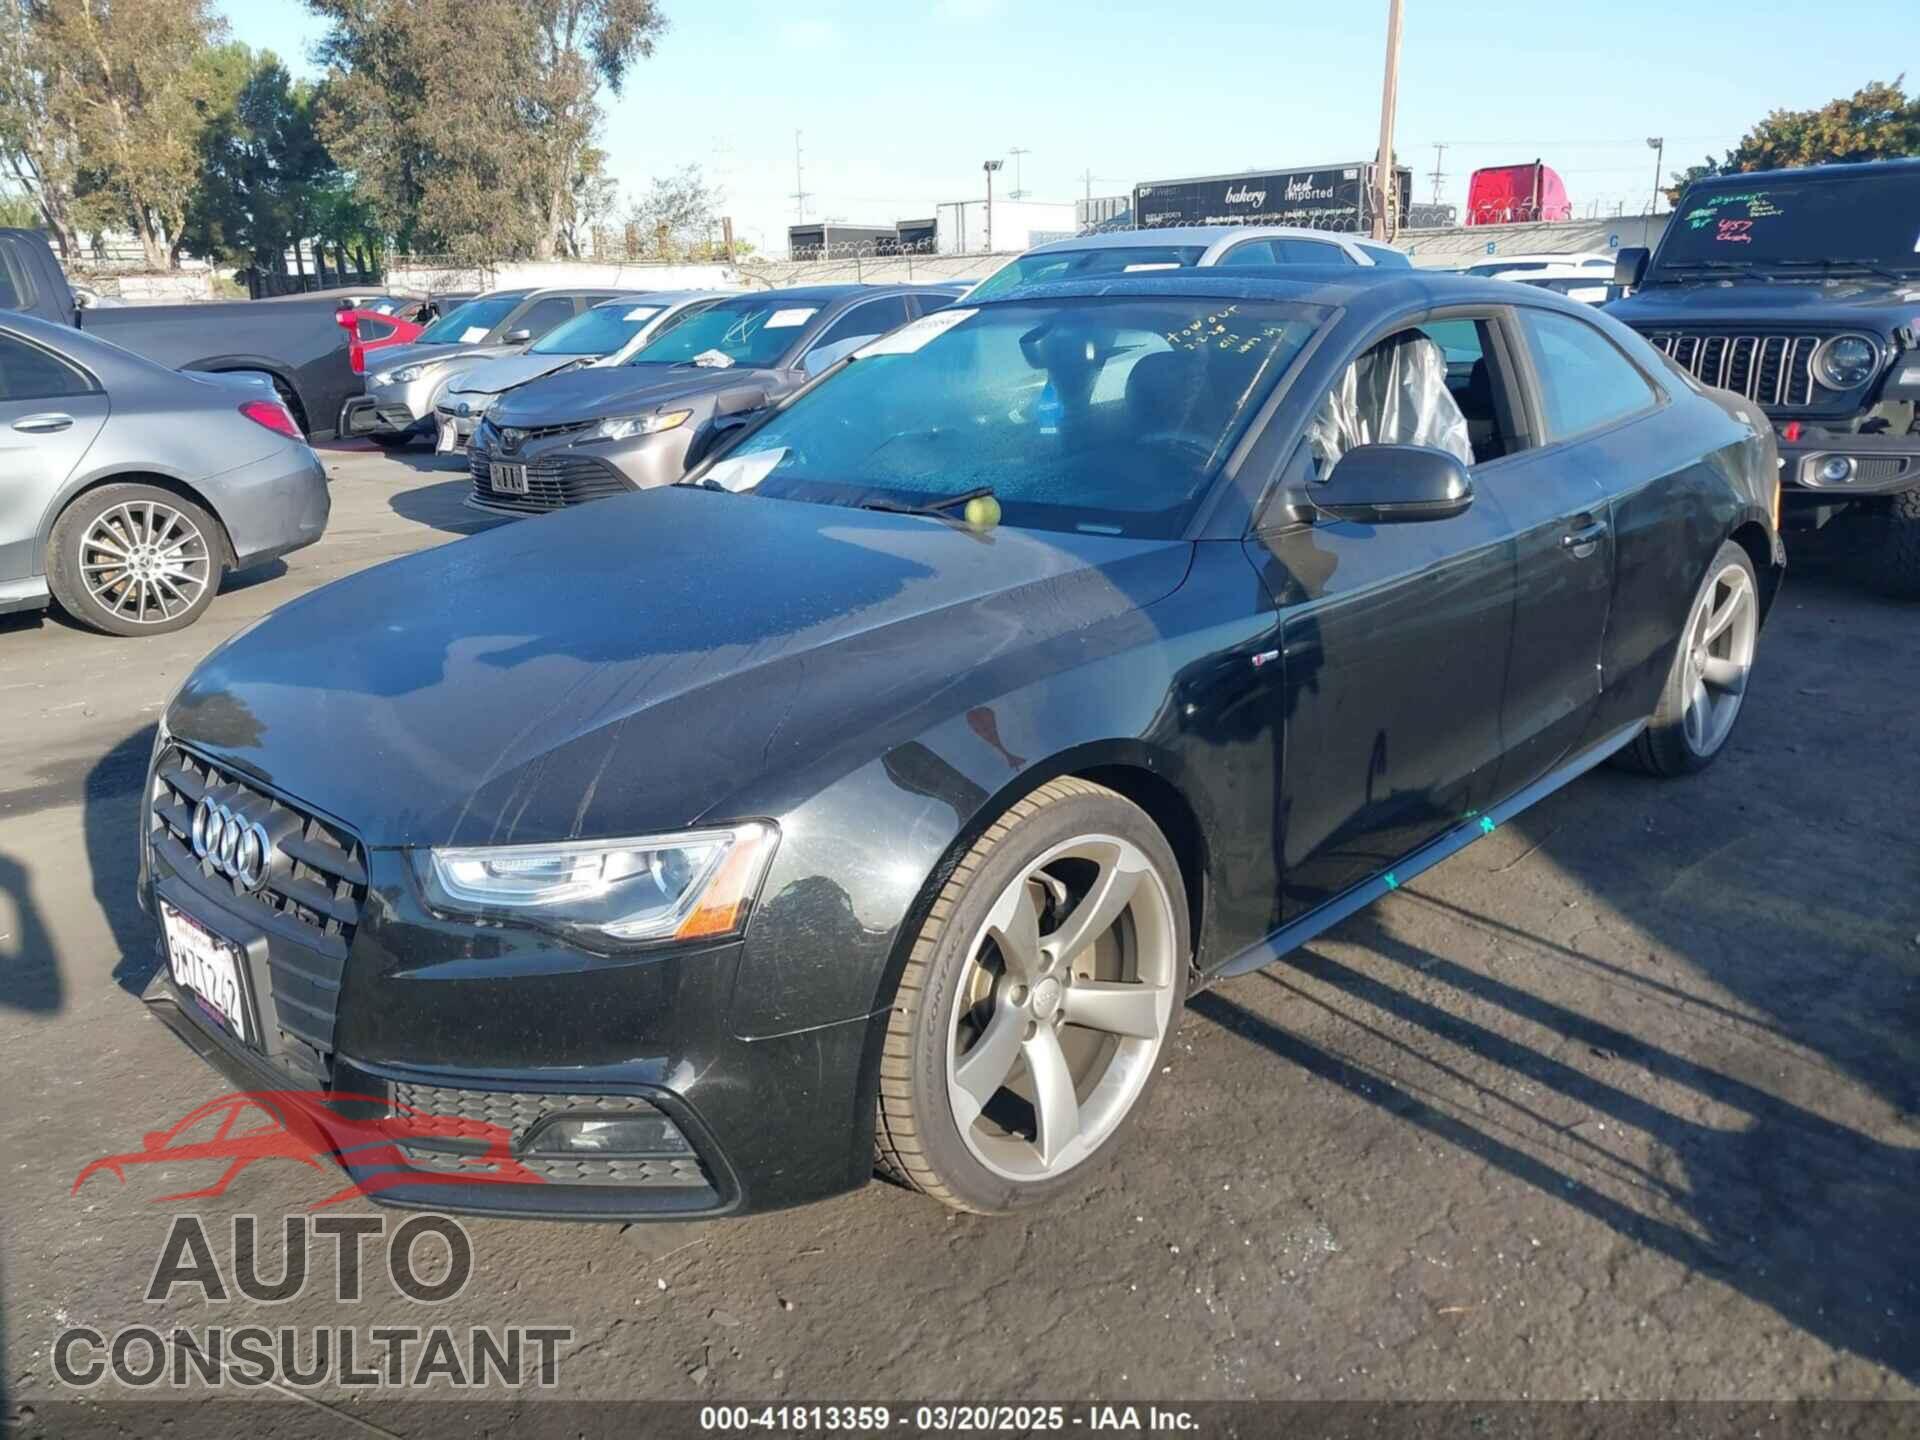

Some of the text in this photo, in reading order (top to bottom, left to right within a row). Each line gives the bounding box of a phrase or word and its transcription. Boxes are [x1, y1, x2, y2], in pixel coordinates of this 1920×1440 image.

[1225, 185, 1267, 208] bakery
[1284, 186, 1334, 202] imported
[1486, 241, 1497, 255] B
